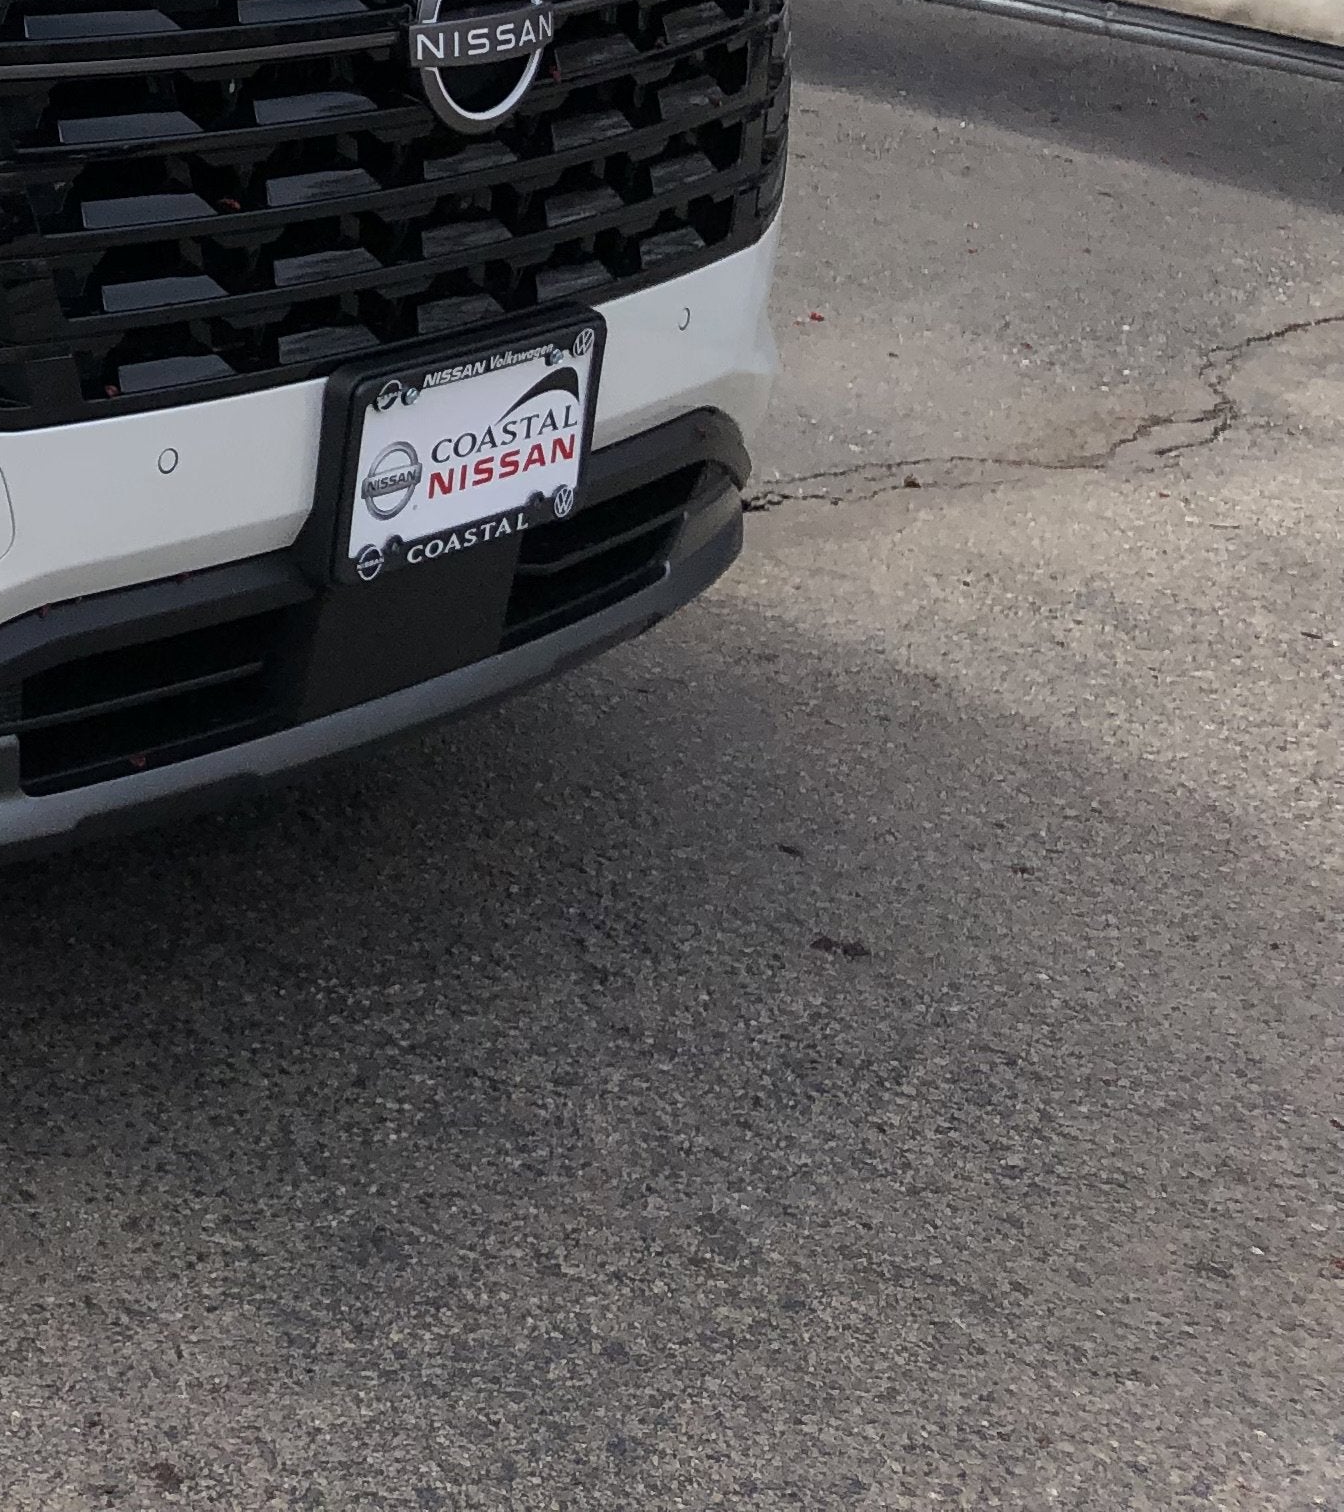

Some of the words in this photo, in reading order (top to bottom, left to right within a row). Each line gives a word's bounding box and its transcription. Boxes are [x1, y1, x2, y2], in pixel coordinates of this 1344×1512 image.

[417, 11, 552, 60] NISSAN
[423, 360, 486, 387] NISSAN
[431, 405, 577, 464] COASTAL
[368, 469, 416, 491] NISSAN
[427, 433, 575, 499] NISSAN
[407, 513, 528, 563] COASTAL
